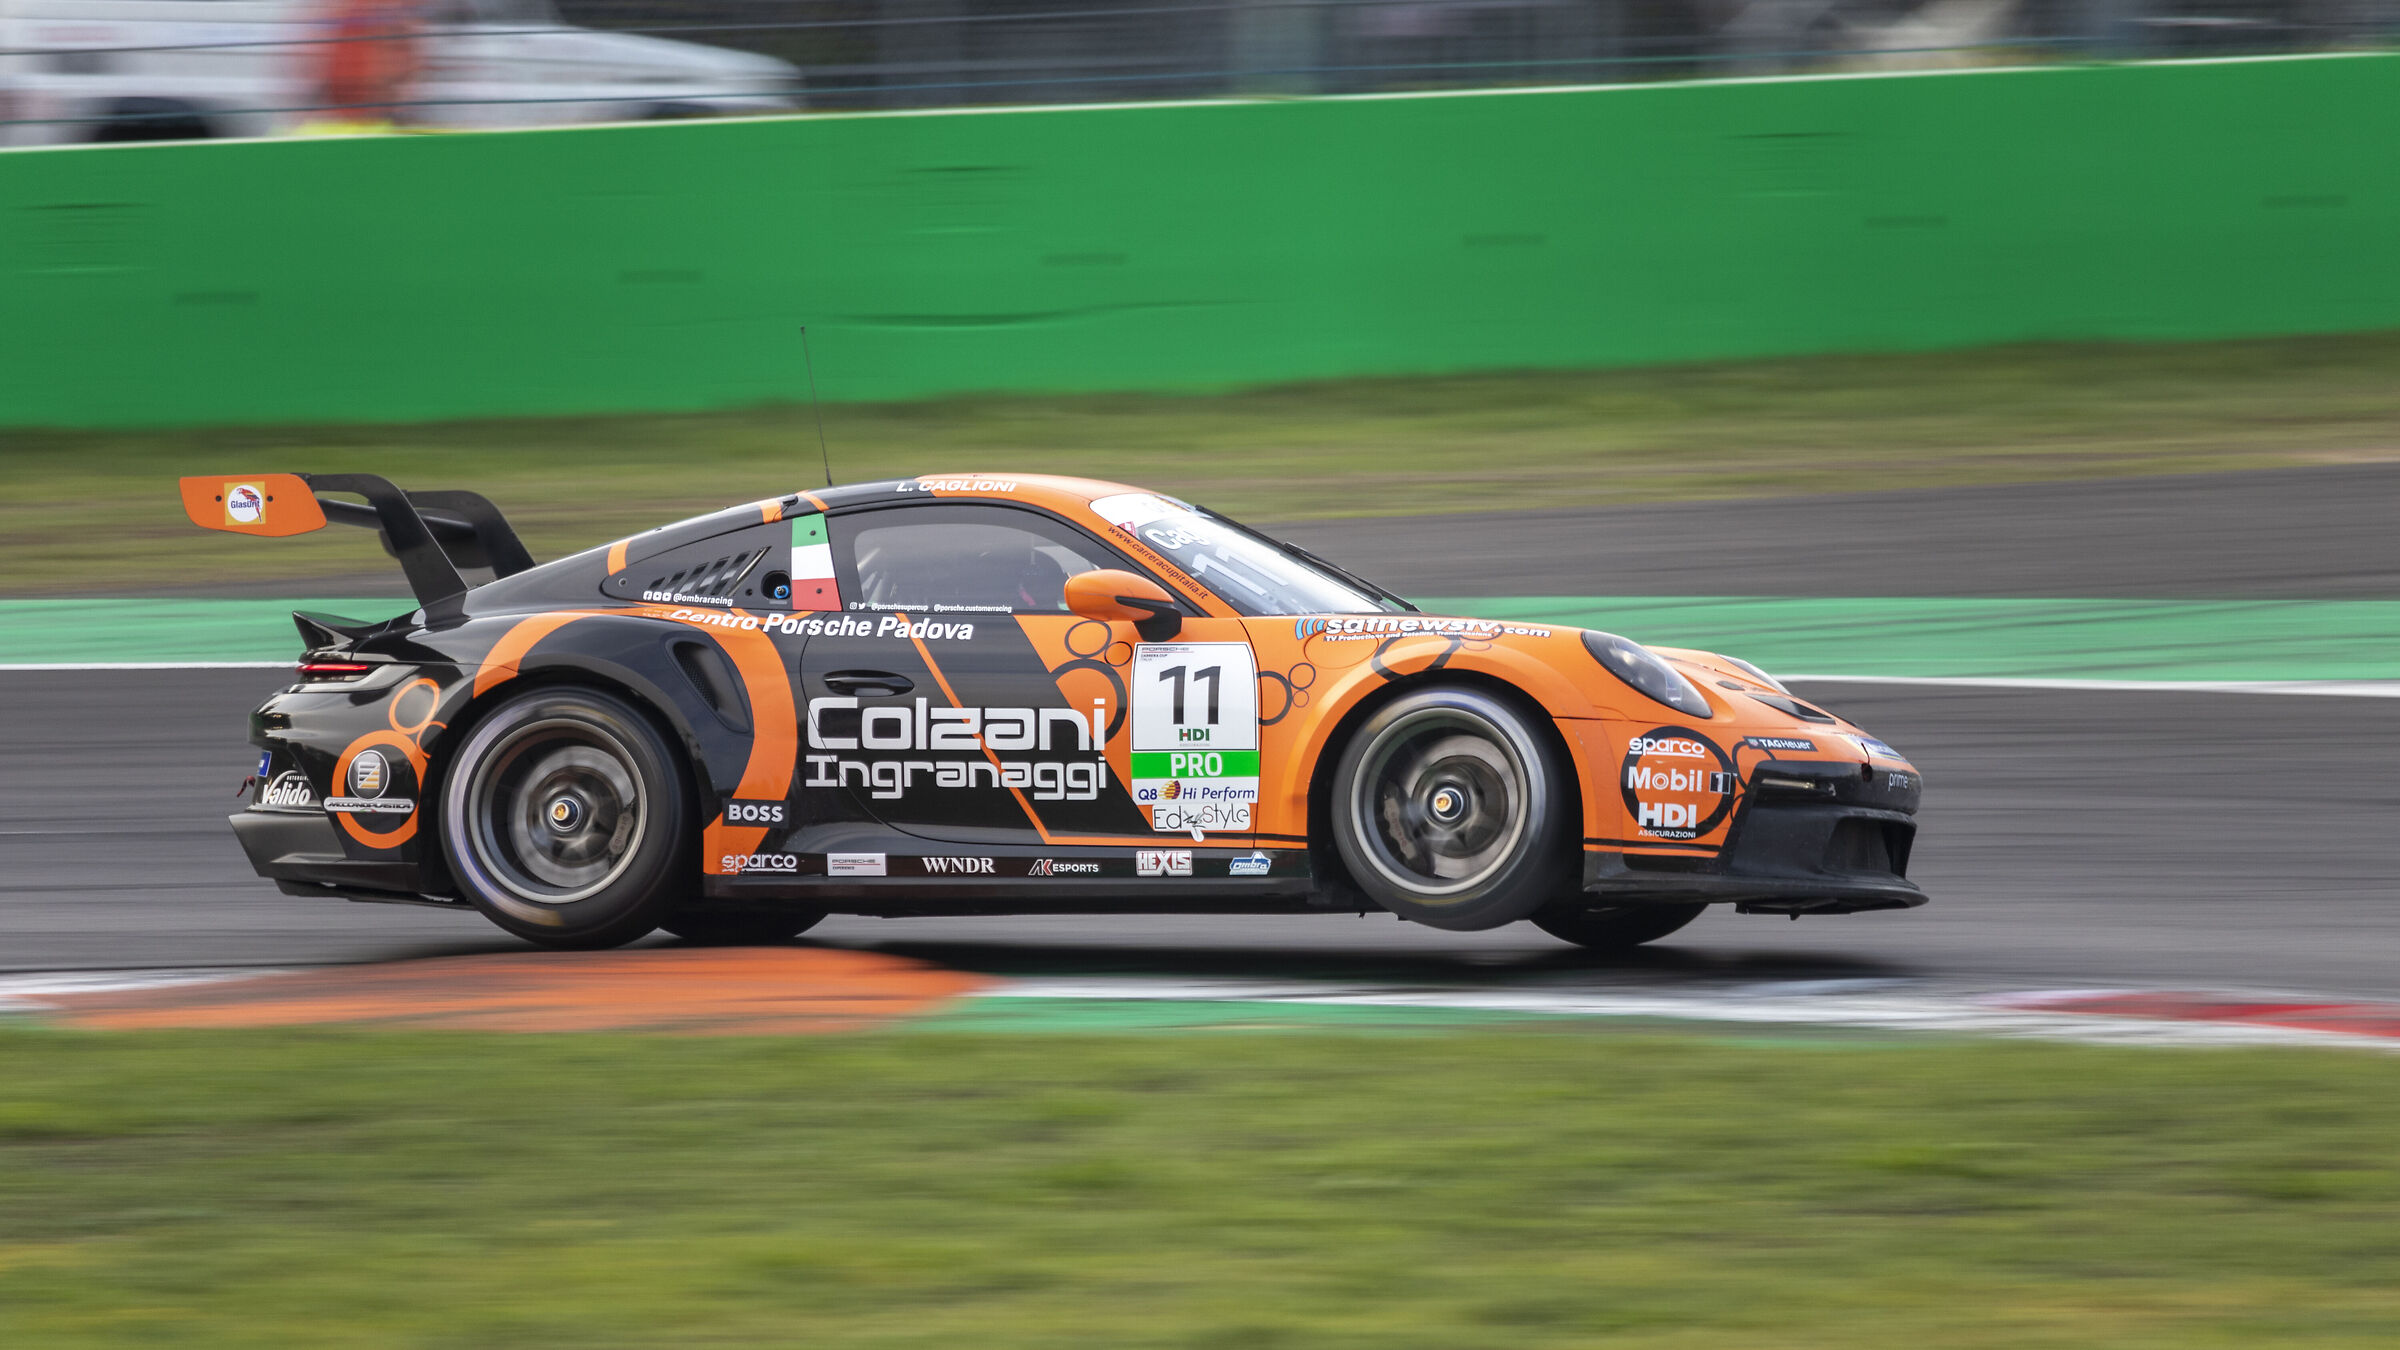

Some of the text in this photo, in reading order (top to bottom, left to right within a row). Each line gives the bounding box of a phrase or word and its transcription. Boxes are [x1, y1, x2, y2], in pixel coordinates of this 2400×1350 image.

[896, 480, 1017, 493] L. CAGLIONI
[1107, 525, 1209, 600] www.carreracupitalia.it
[673, 593, 734, 607] @ombraracing
[871, 602, 1013, 614] @porschesupercup @porsche.customerracing
[669, 609, 759, 631] Centro
[762, 613, 872, 637] Porsche
[876, 616, 975, 640] Padova
[1325, 616, 1552, 638] satnewstv.com
[1159, 665, 1221, 725] 11
[807, 697, 1106, 751] Colzani
[1179, 728, 1210, 741] HDI
[1628, 737, 1705, 758] sparco
[1170, 752, 1222, 777] PRO
[805, 754, 1107, 801] Ingranaggi
[1627, 766, 1703, 793] Mobil
[1888, 772, 1909, 793] prime
[261, 781, 312, 806] Valido
[1138, 786, 1255, 802] Q8 Hi Perform
[728, 804, 784, 822] BOSS
[1202, 803, 1249, 829] Style
[1638, 802, 1697, 829] HDI
[1638, 829, 1697, 839] ASSICURAZIONI
[721, 854, 798, 872] sparco
[921, 857, 997, 874] WNDR
[1052, 863, 1099, 873] ESPORTS
[1137, 851, 1191, 873] HEXIS
